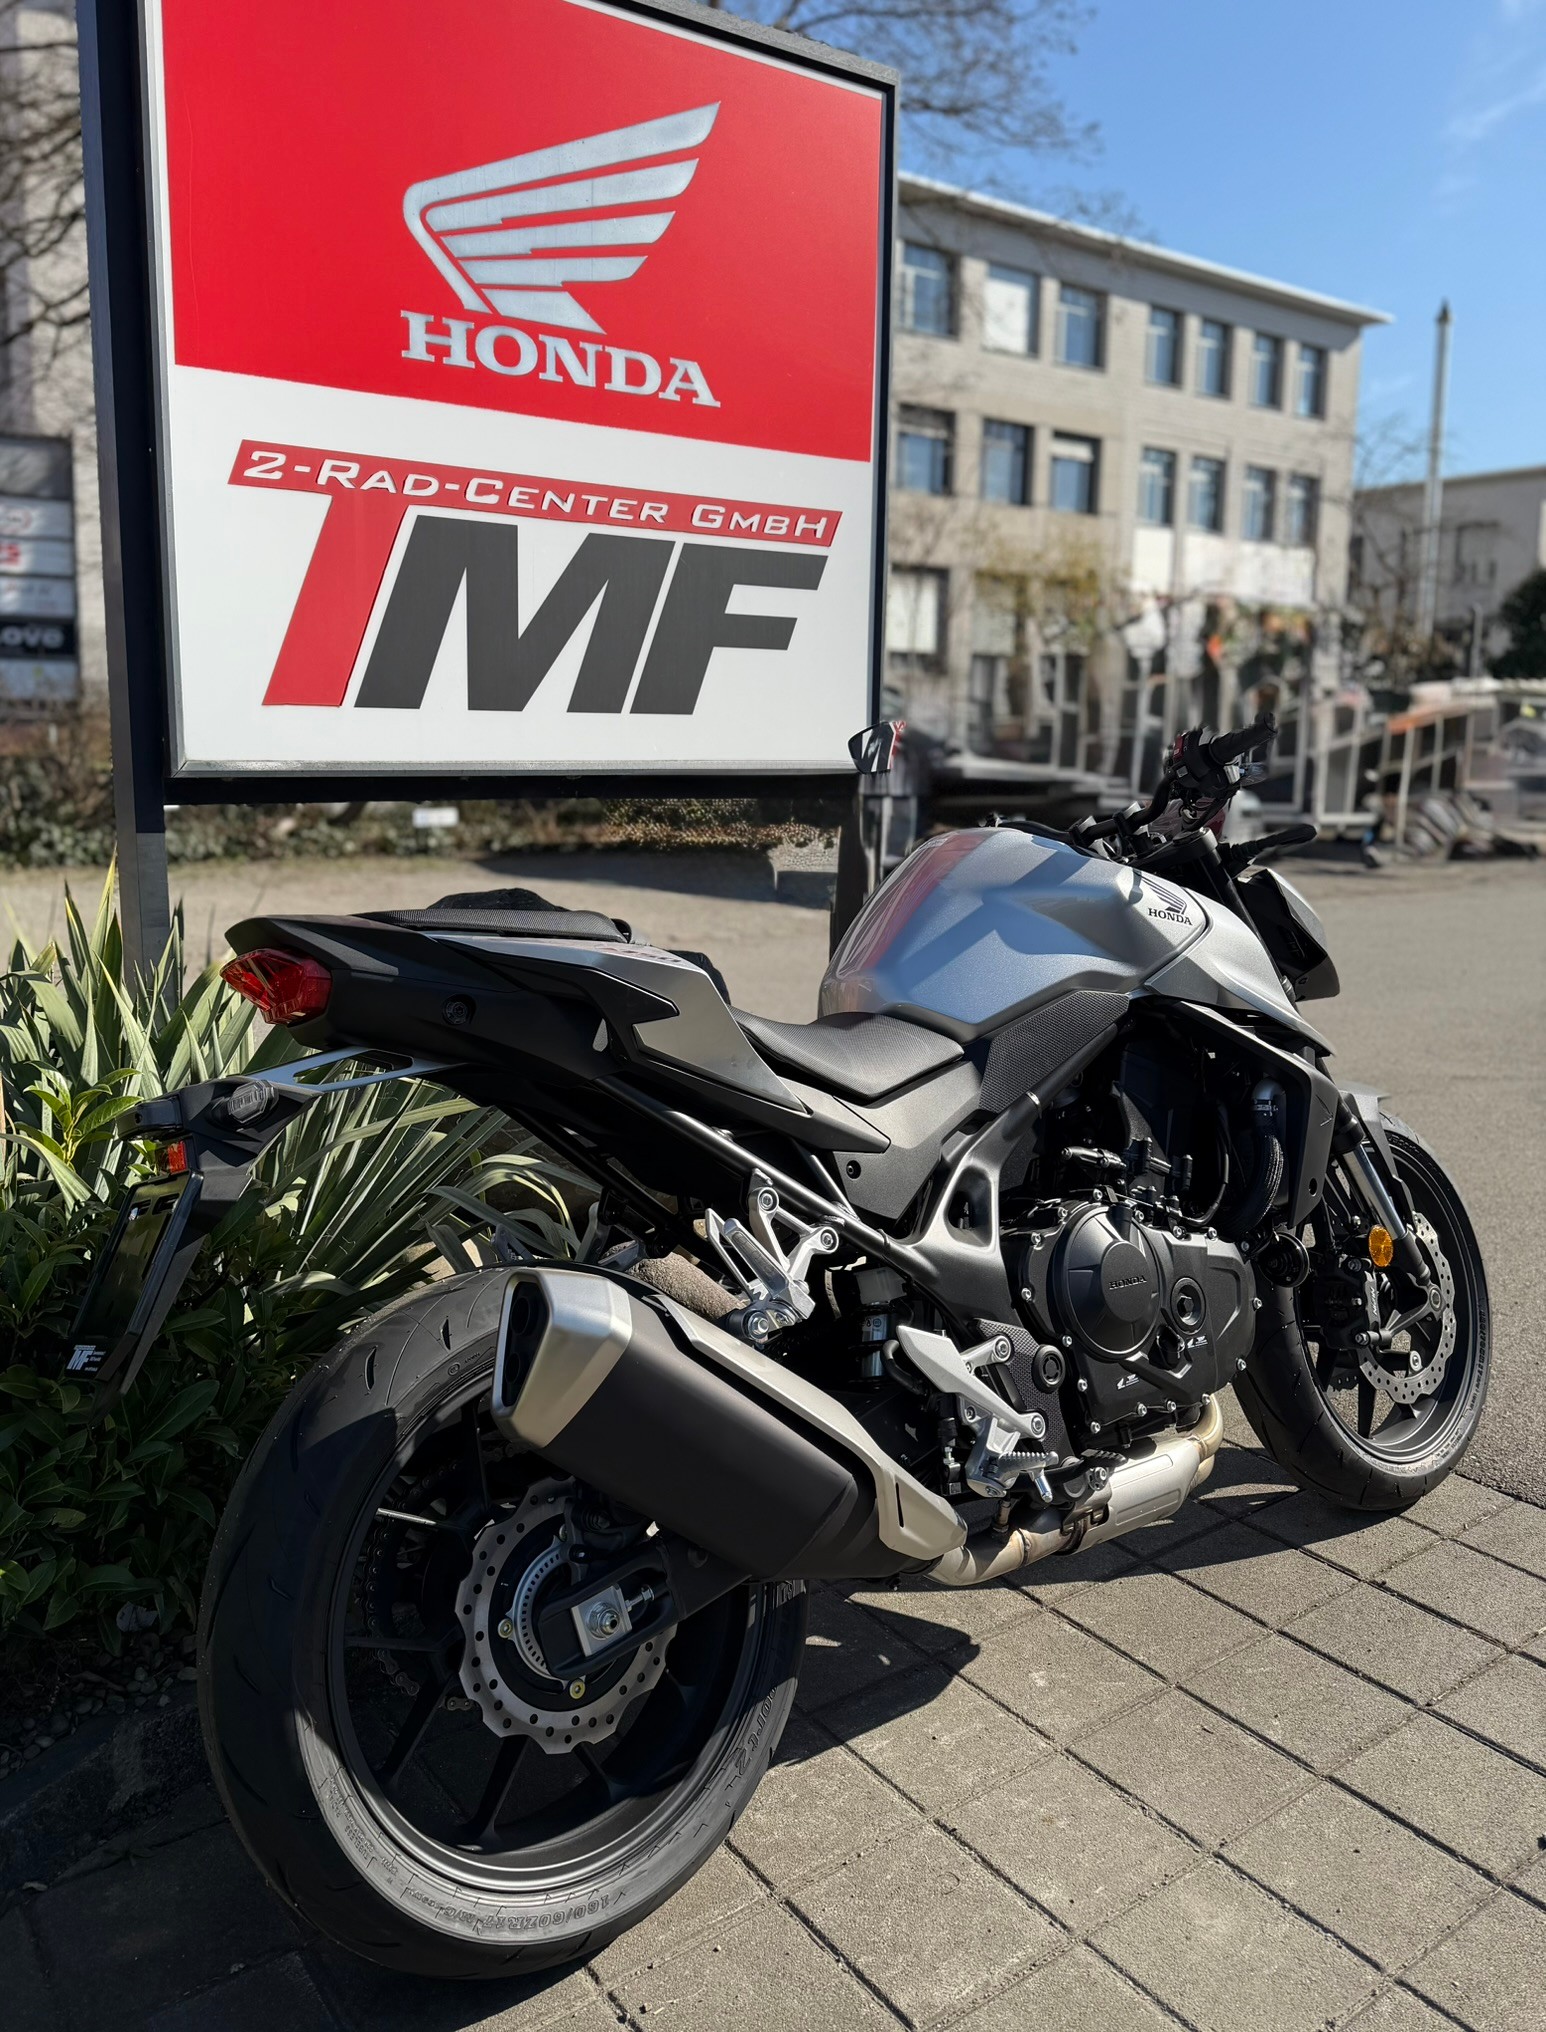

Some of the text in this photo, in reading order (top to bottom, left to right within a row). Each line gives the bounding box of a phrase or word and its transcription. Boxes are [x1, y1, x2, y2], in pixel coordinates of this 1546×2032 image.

[401, 310, 721, 407] HONDA
[230, 440, 843, 715] TMF
[1148, 908, 1193, 926] HONDA
[1109, 1275, 1147, 1290] HONDA
[482, 1894, 610, 1930] 160/60ZR17
